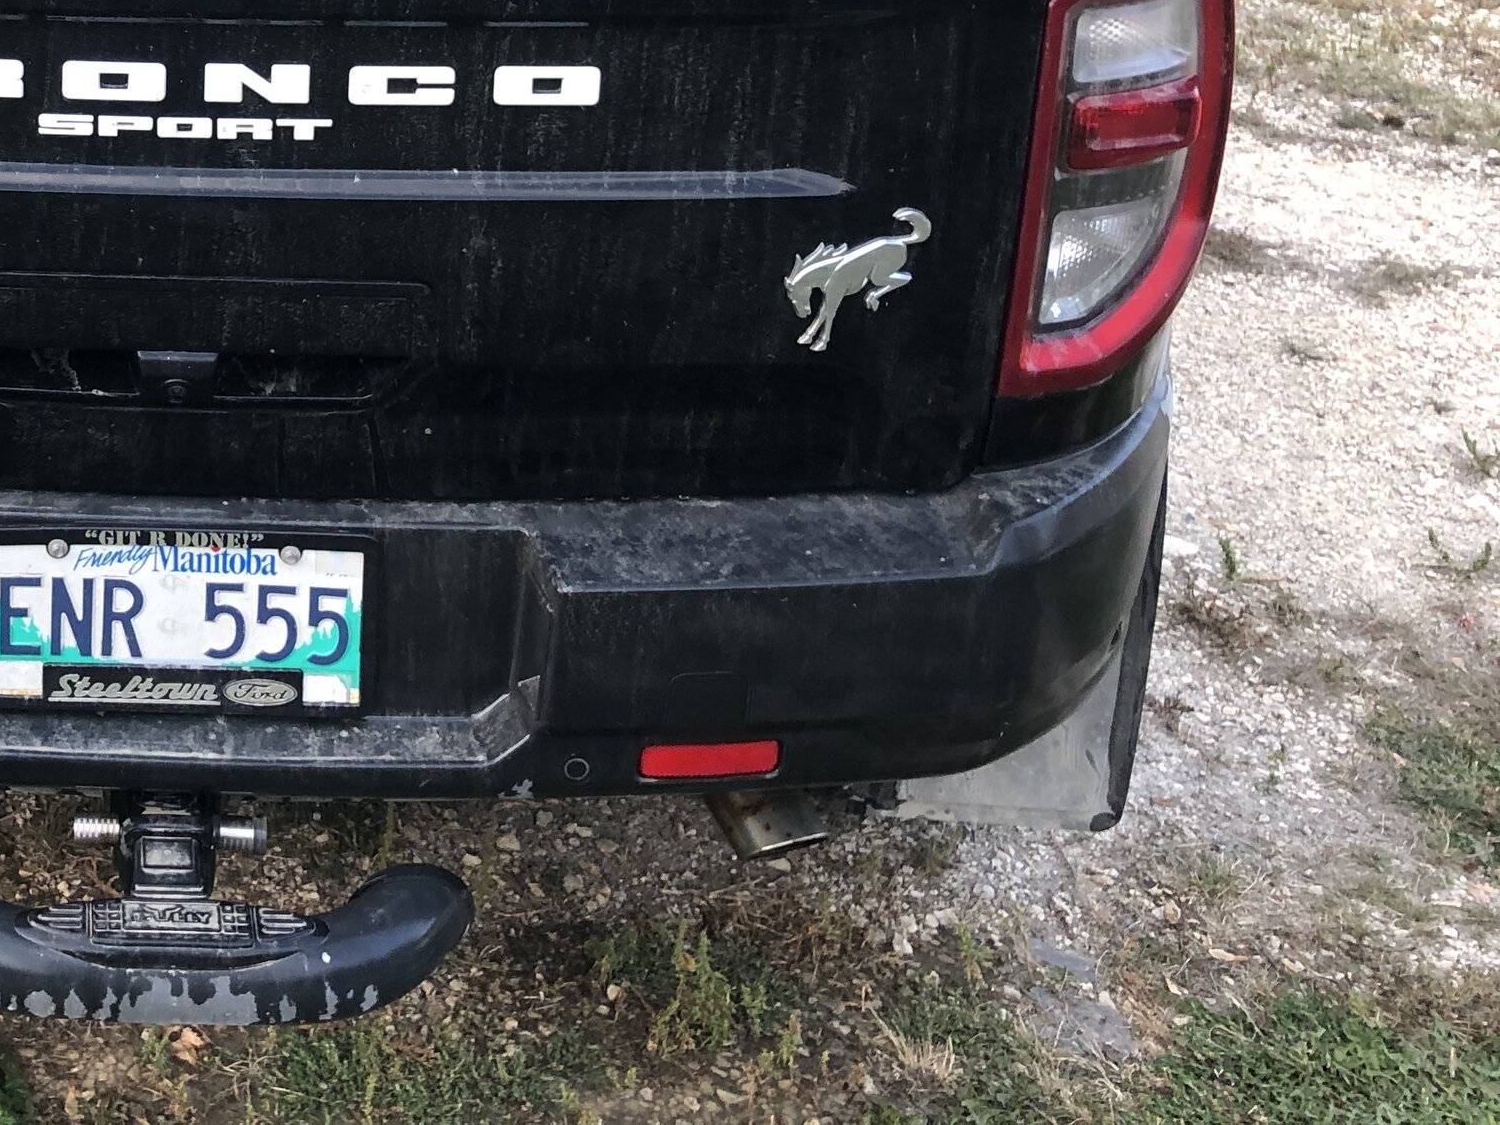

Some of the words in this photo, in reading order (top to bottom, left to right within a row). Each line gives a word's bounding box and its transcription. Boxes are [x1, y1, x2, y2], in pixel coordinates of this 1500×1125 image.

[38, 113, 333, 141] SPORT
[150, 531, 166, 546] R
[73, 546, 156, 575] Friendly
[152, 546, 278, 575] Manitoba
[0, 576, 144, 659] ENR
[204, 582, 349, 665] 555
[51, 673, 219, 701] Steeltown
